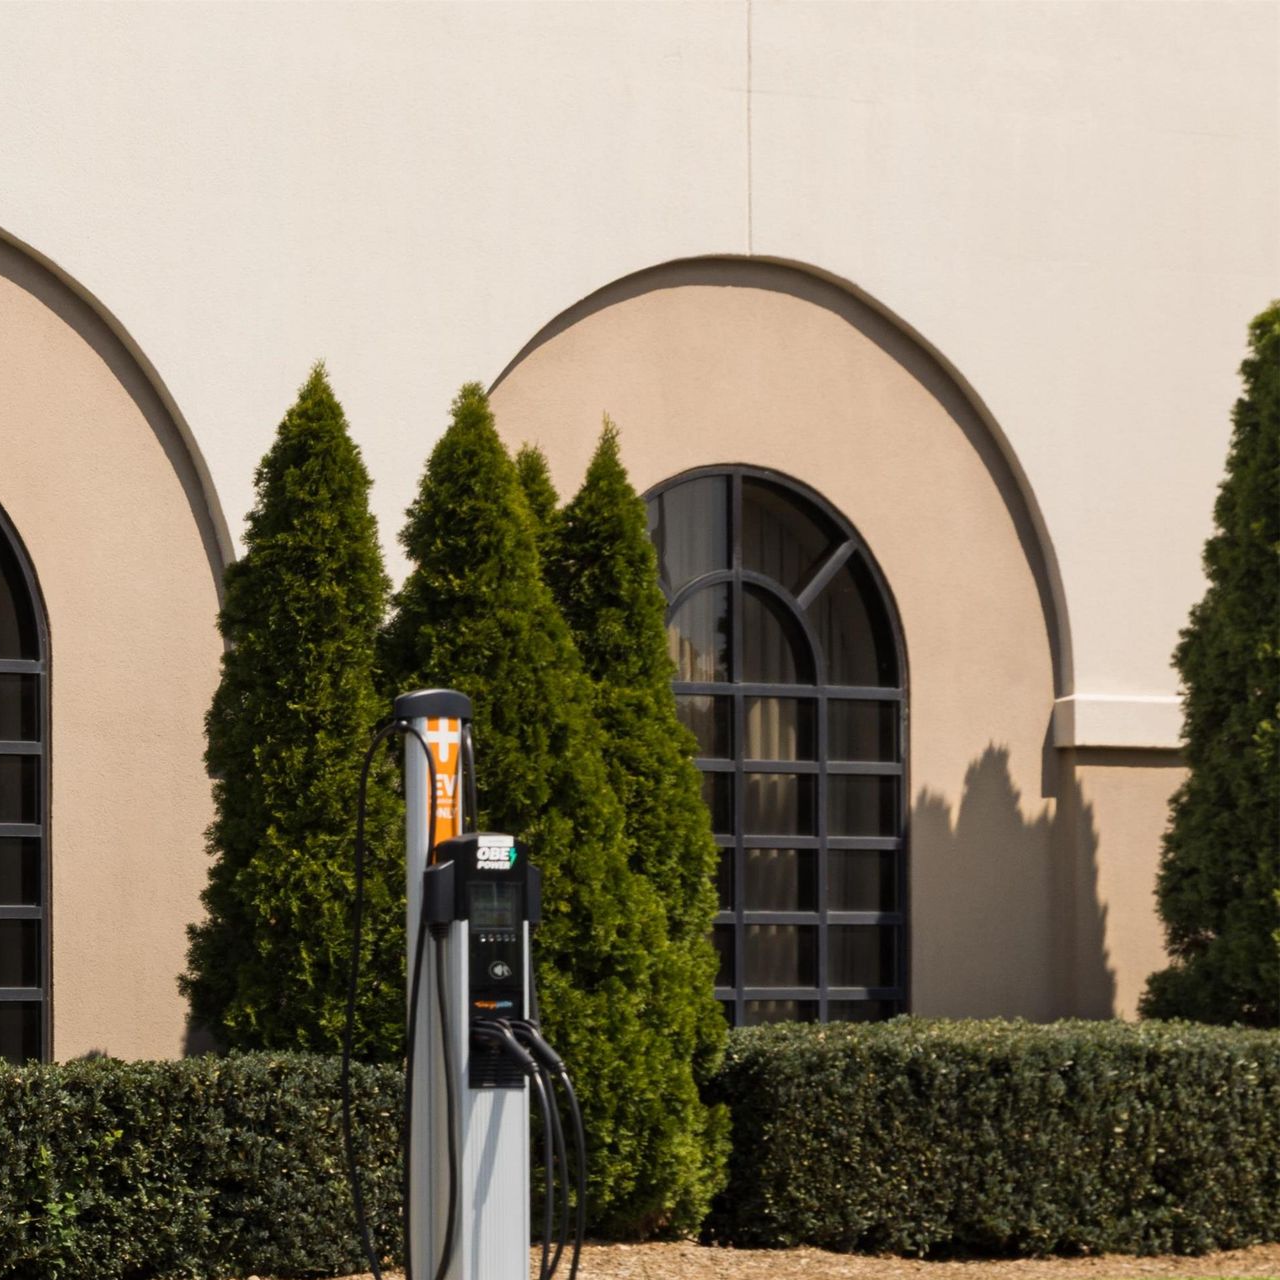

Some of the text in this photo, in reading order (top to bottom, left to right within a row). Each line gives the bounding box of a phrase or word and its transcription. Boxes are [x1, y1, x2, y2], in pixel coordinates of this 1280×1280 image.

[435, 773, 458, 797] EV
[435, 806, 456, 819] NLY
[476, 847, 510, 860] OBE
[476, 860, 511, 870] POWER
